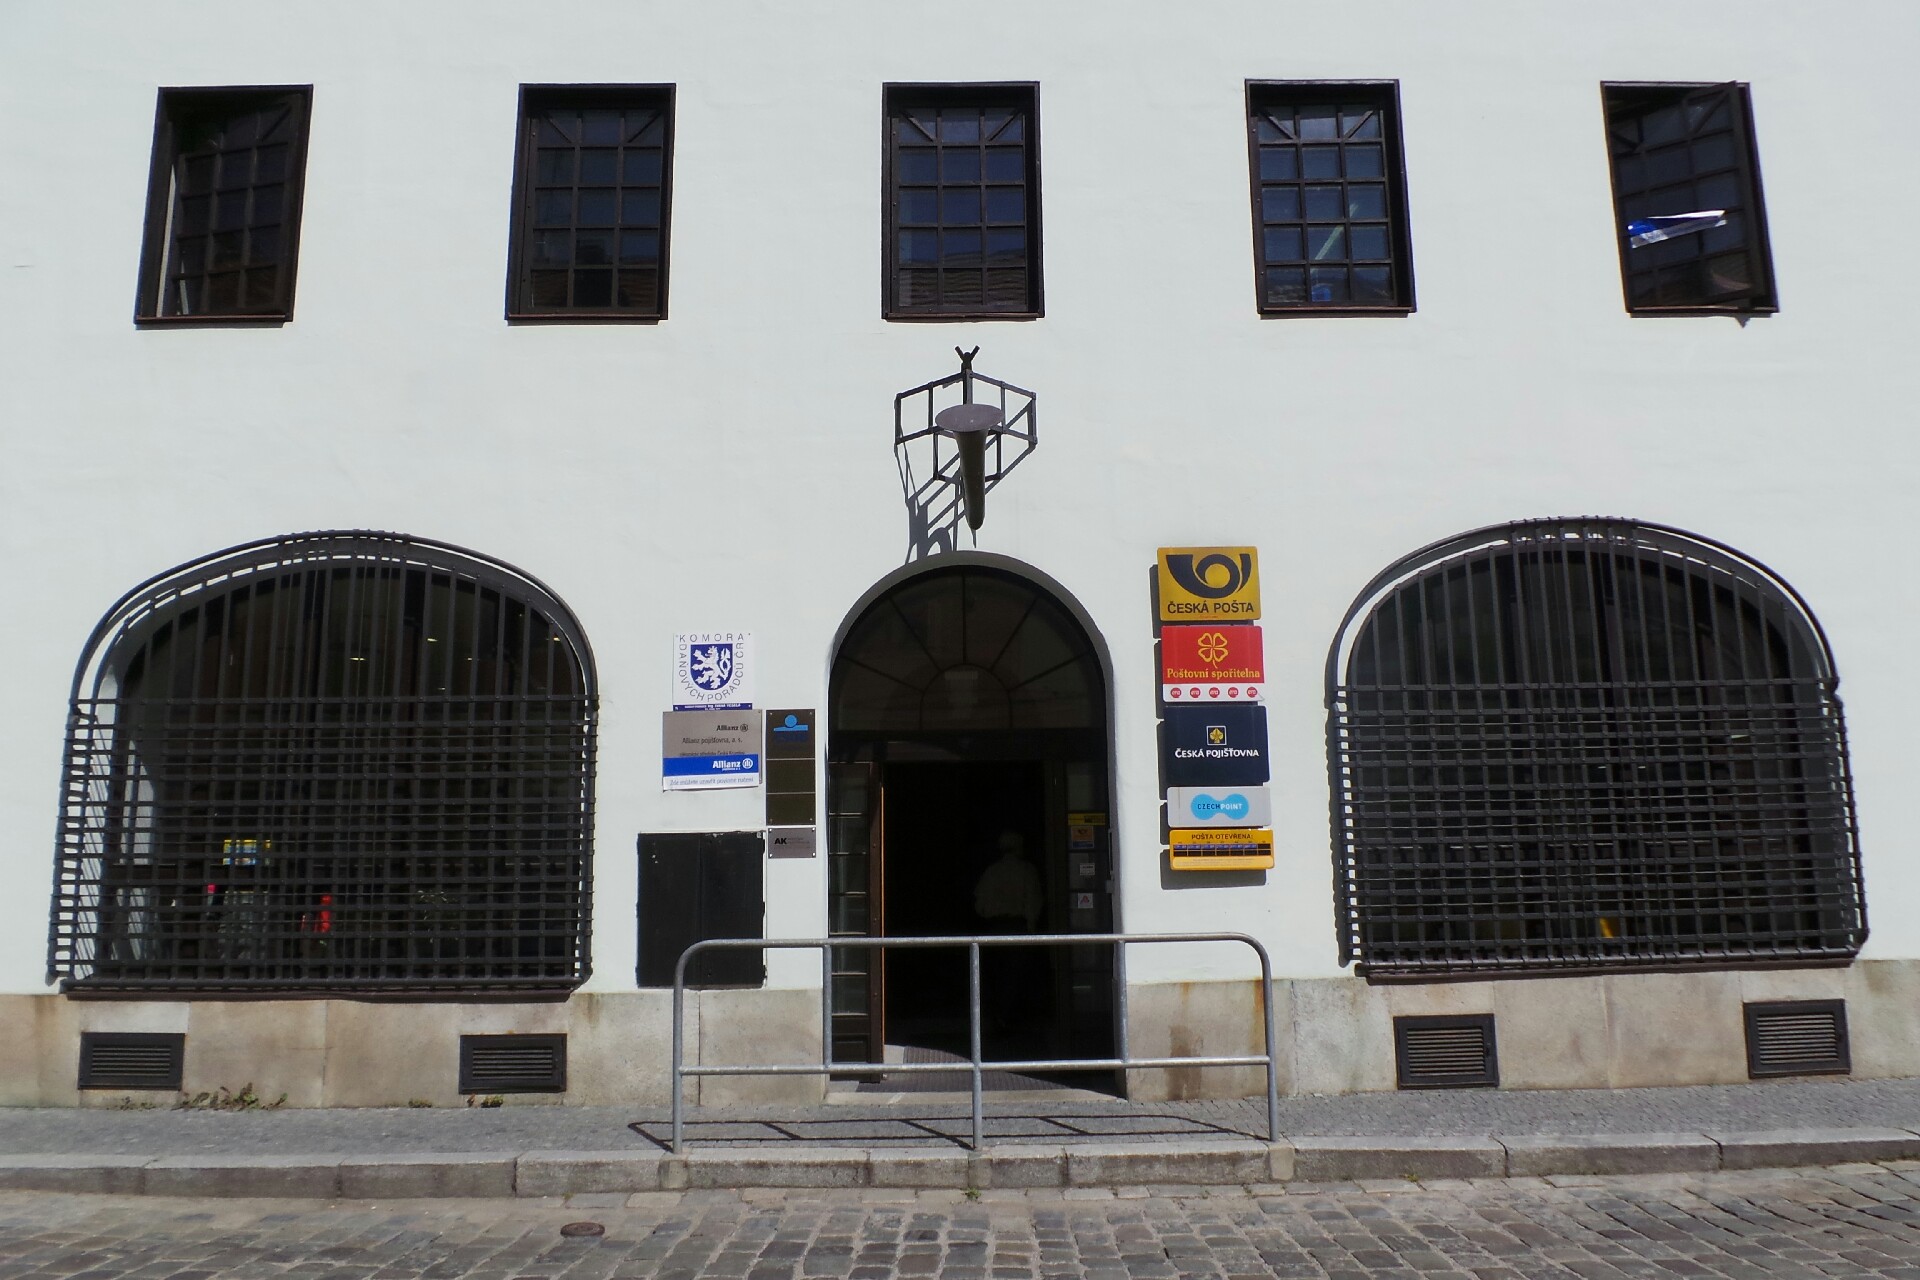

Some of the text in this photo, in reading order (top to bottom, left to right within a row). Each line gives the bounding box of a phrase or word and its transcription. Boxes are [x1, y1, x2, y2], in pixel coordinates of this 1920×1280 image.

[1167, 600, 1254, 614] ČESKÁ POŠTA
[679, 633, 744, 643] KOMORA
[1167, 667, 1260, 680] Poštovní spořitelna
[716, 724, 739, 732] Allianz
[1174, 748, 1260, 759] ČESKÁ POJIŠŤOVNA
[712, 760, 741, 769] Allianz
[1191, 832, 1214, 840] POŠTA
[774, 837, 787, 845] AK
